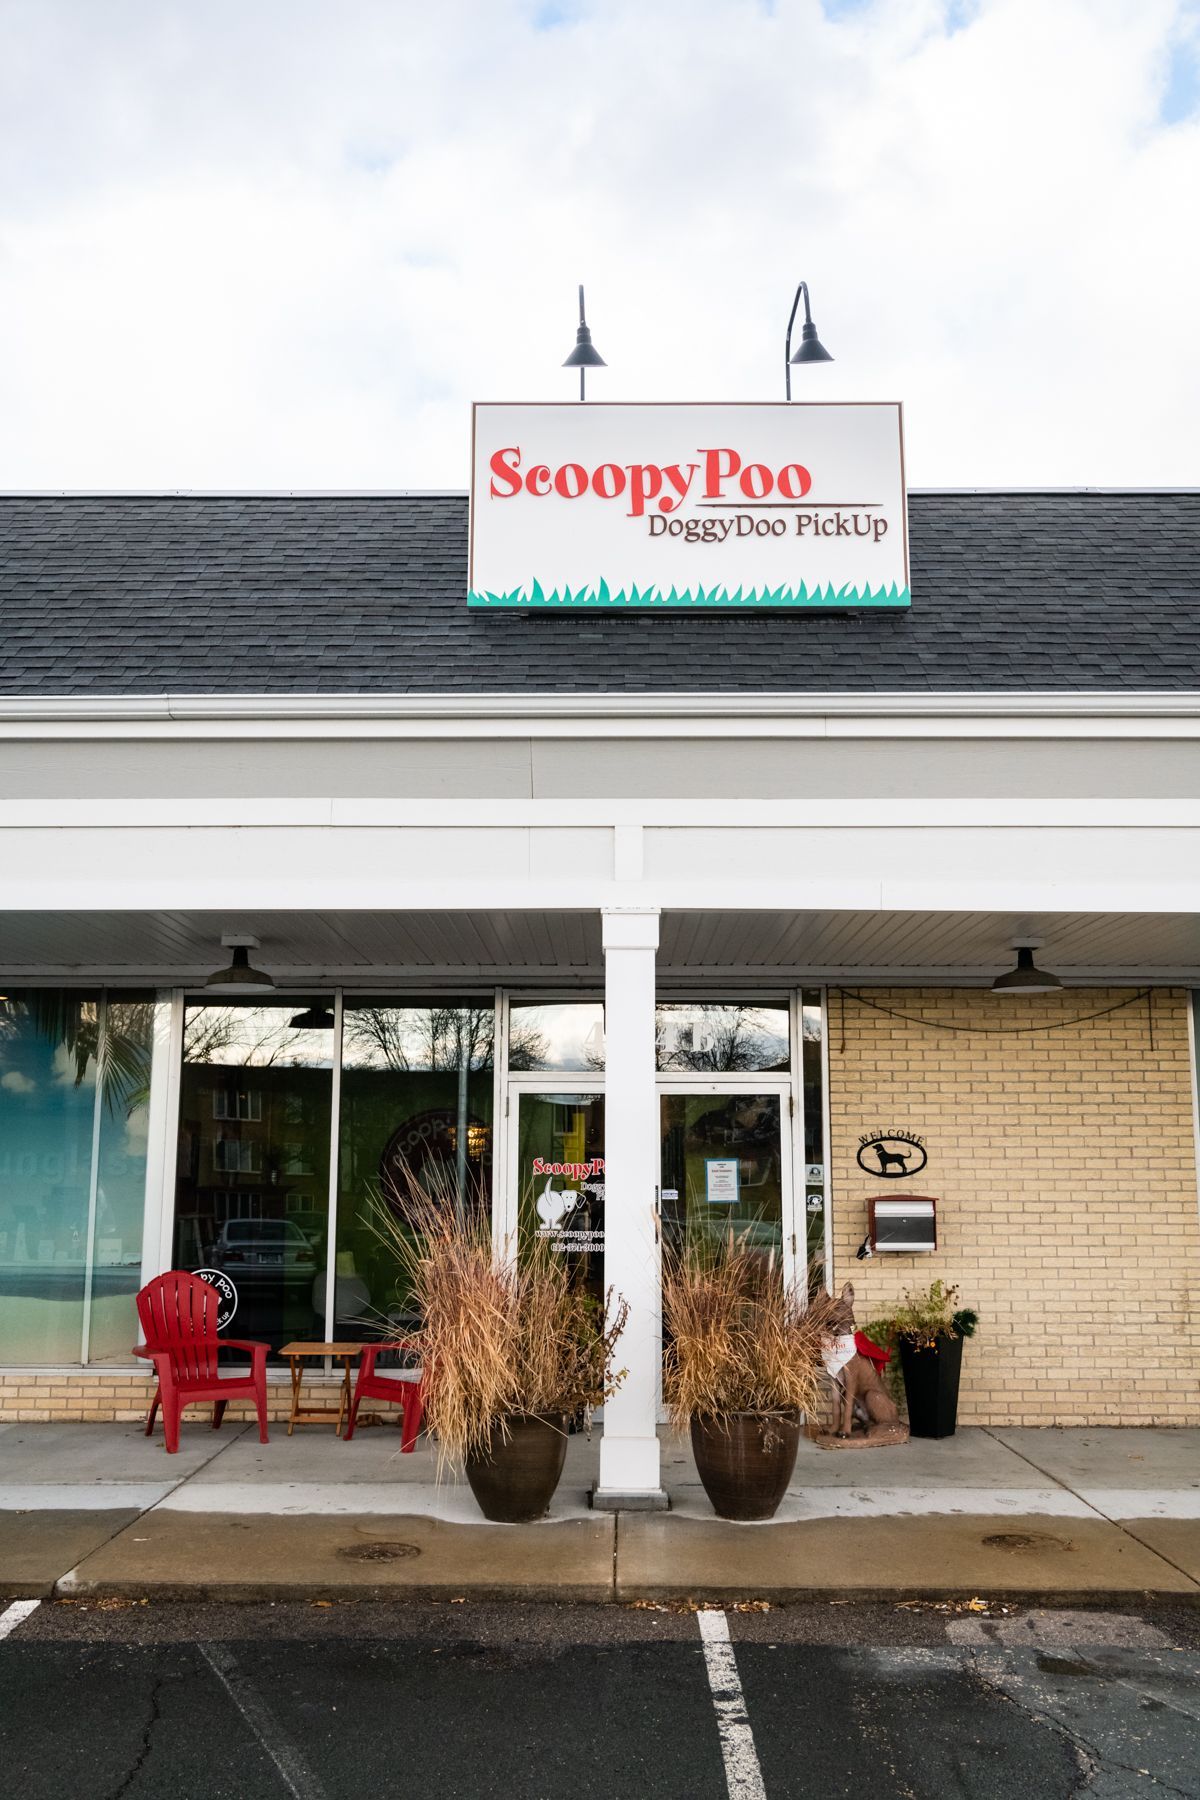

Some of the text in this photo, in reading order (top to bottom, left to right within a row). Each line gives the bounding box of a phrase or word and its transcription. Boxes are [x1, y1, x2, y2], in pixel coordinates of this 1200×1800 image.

[489, 446, 812, 516] ScoopyPoo
[648, 513, 888, 543] DoggyDoo PickUp
[858, 1129, 925, 1145] WELCOME
[533, 1157, 605, 1181] ScoopyP
[535, 1230, 605, 1241] www.scoopypoo
[215, 1278, 232, 1299] poo
